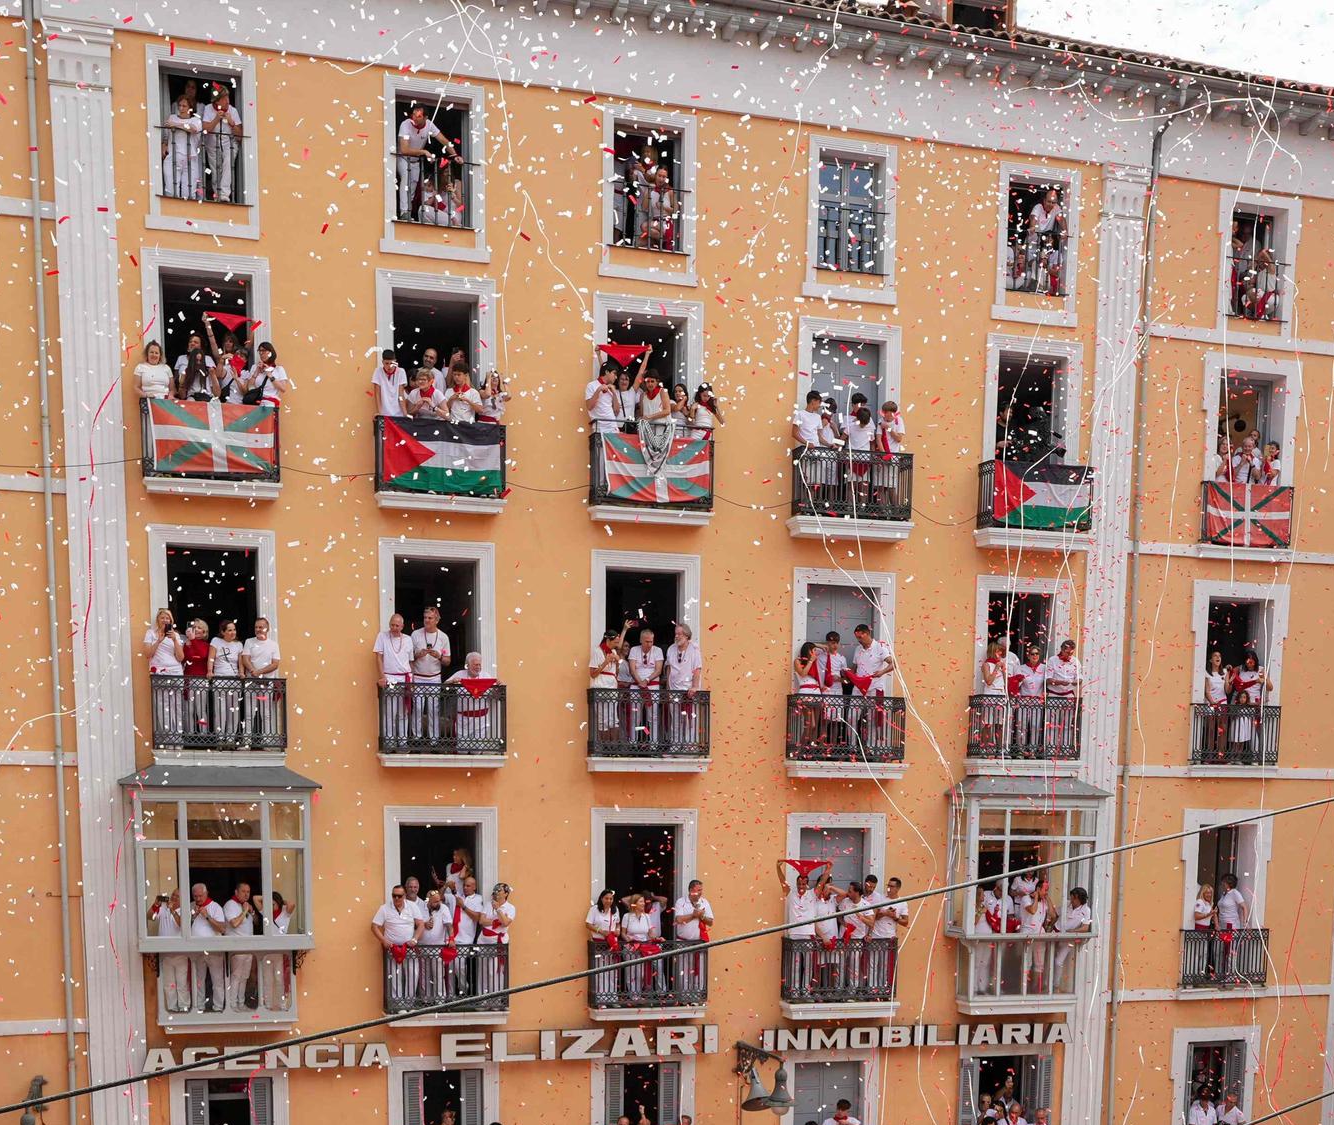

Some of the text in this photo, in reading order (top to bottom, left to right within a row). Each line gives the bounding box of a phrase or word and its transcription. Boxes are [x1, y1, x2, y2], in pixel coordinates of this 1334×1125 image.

[142, 1022, 1070, 1073] AGENCIA ELIZARI INMOBILIARIA
